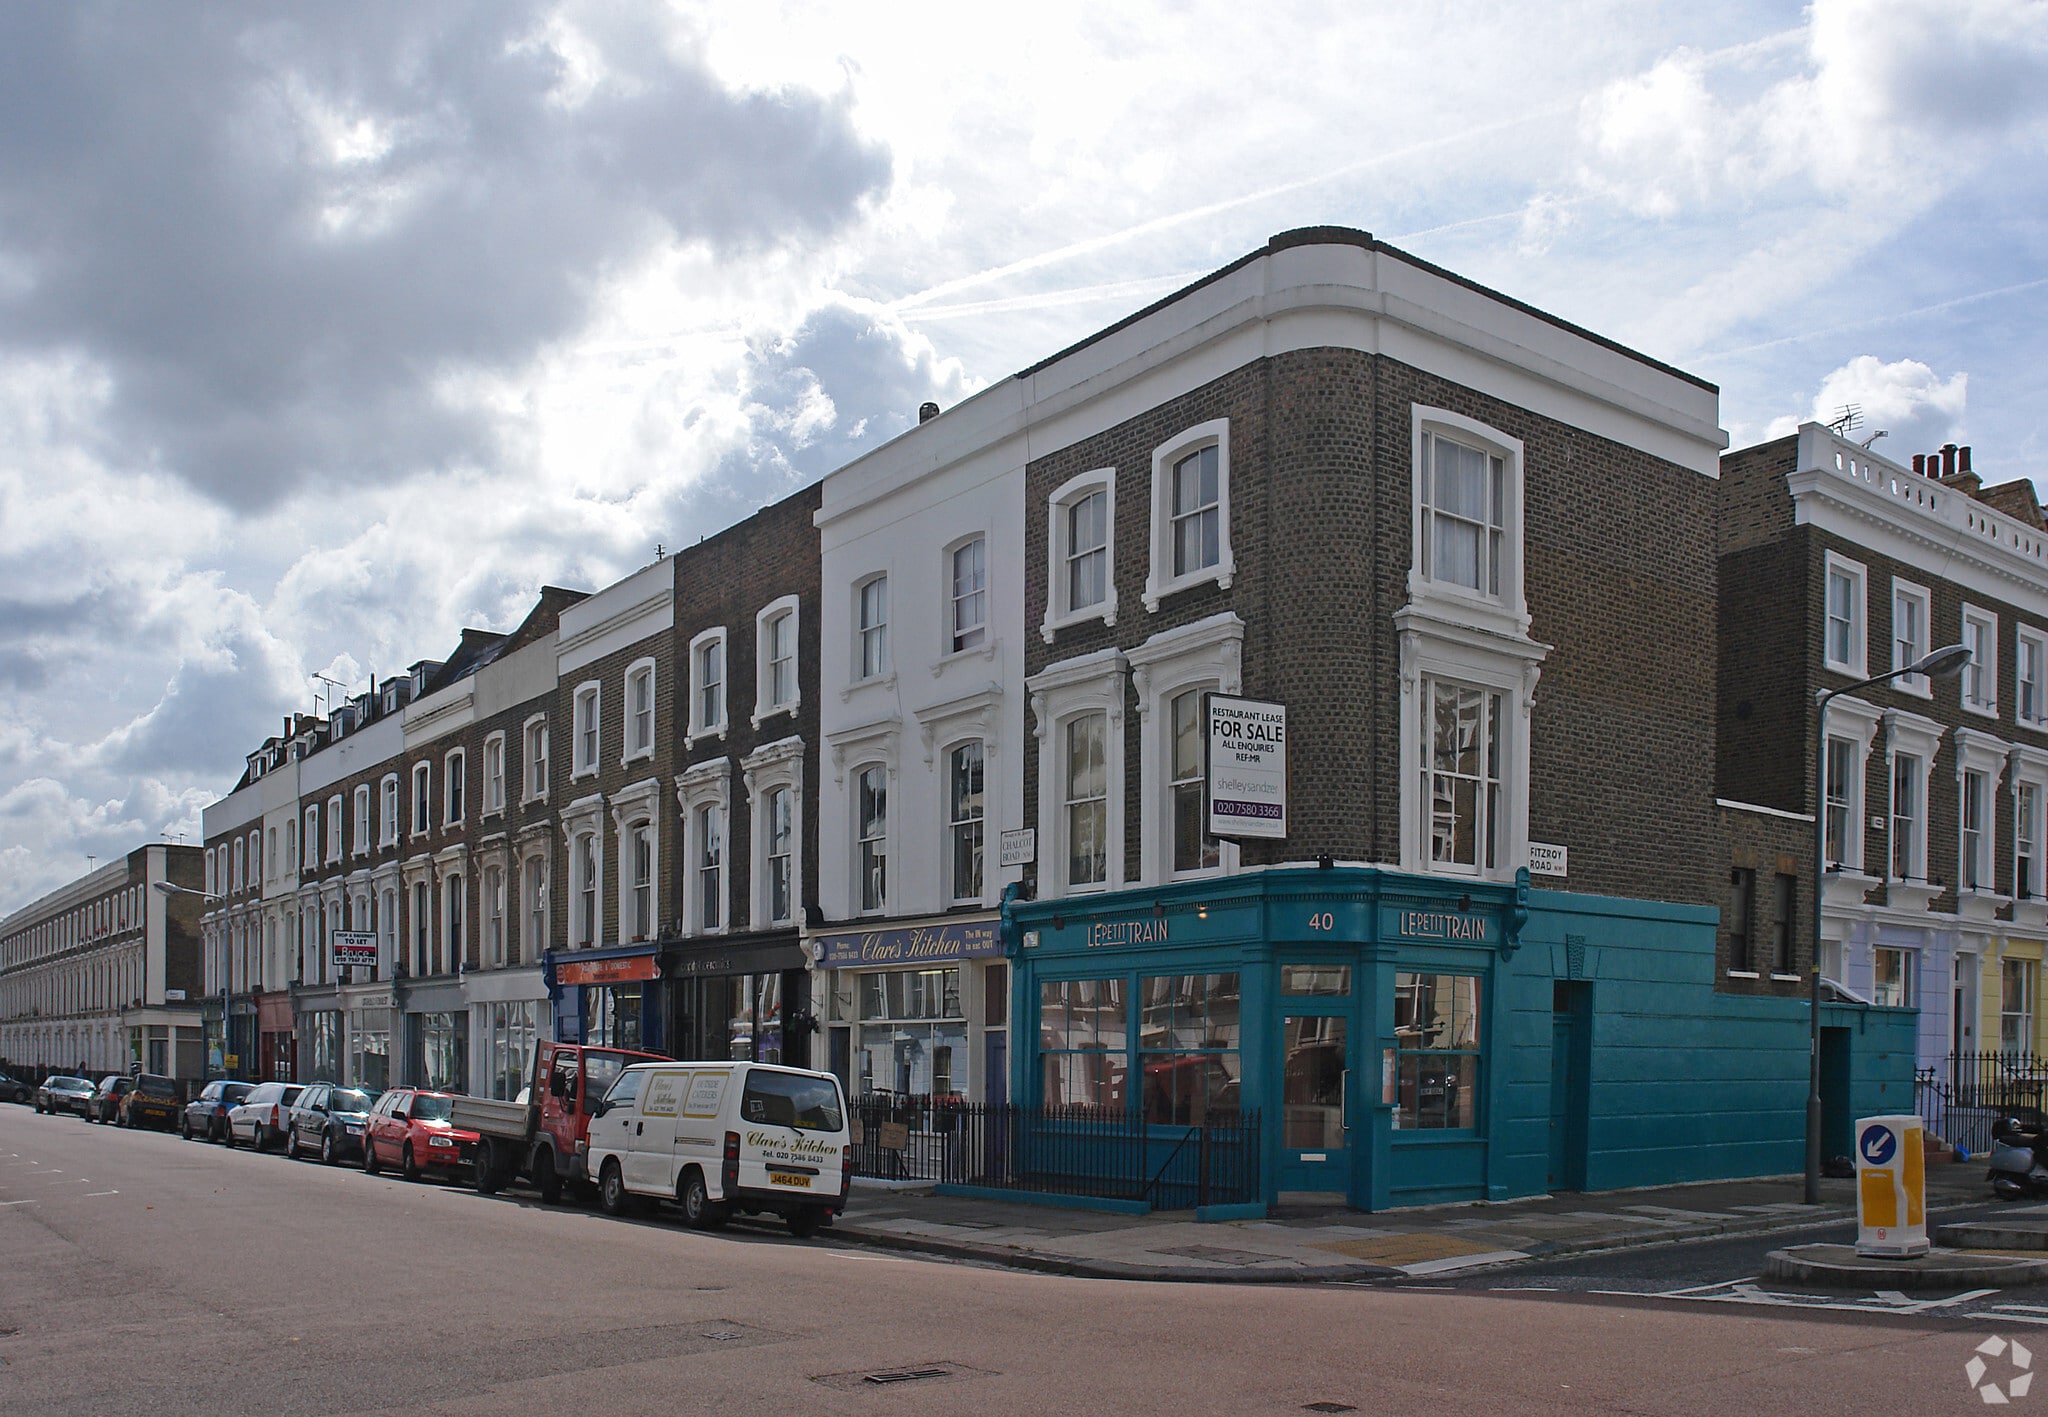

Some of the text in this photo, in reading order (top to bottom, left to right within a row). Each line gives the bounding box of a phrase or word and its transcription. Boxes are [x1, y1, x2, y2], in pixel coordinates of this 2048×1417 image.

[1212, 707, 1284, 724] RESTAURANT LEASE
[1213, 719, 1284, 743] FOR SALE
[1222, 740, 1275, 753] ALL ENQUIRIES
[1217, 802, 1279, 817] 020 7580 3366
[1003, 837, 1032, 850] CHALCOT
[1003, 851, 1020, 861] ROAD
[1530, 847, 1562, 860] FITZROY
[1530, 860, 1551, 870] ROAD
[1308, 912, 1334, 931] 40
[1445, 915, 1486, 940] TRAIN
[965, 930, 975, 939] The
[981, 930, 993, 939] way
[1127, 919, 1168, 944] TRAIN
[861, 927, 961, 961] Clare's Kitchen
[982, 939, 993, 949] OUT
[342, 946, 370, 957] Bruce
[747, 1131, 838, 1155] Clare's Kitchen
[762, 1150, 775, 1158] Tel.
[776, 1152, 789, 1160] 020
[771, 1174, 810, 1187] J464 DUV
